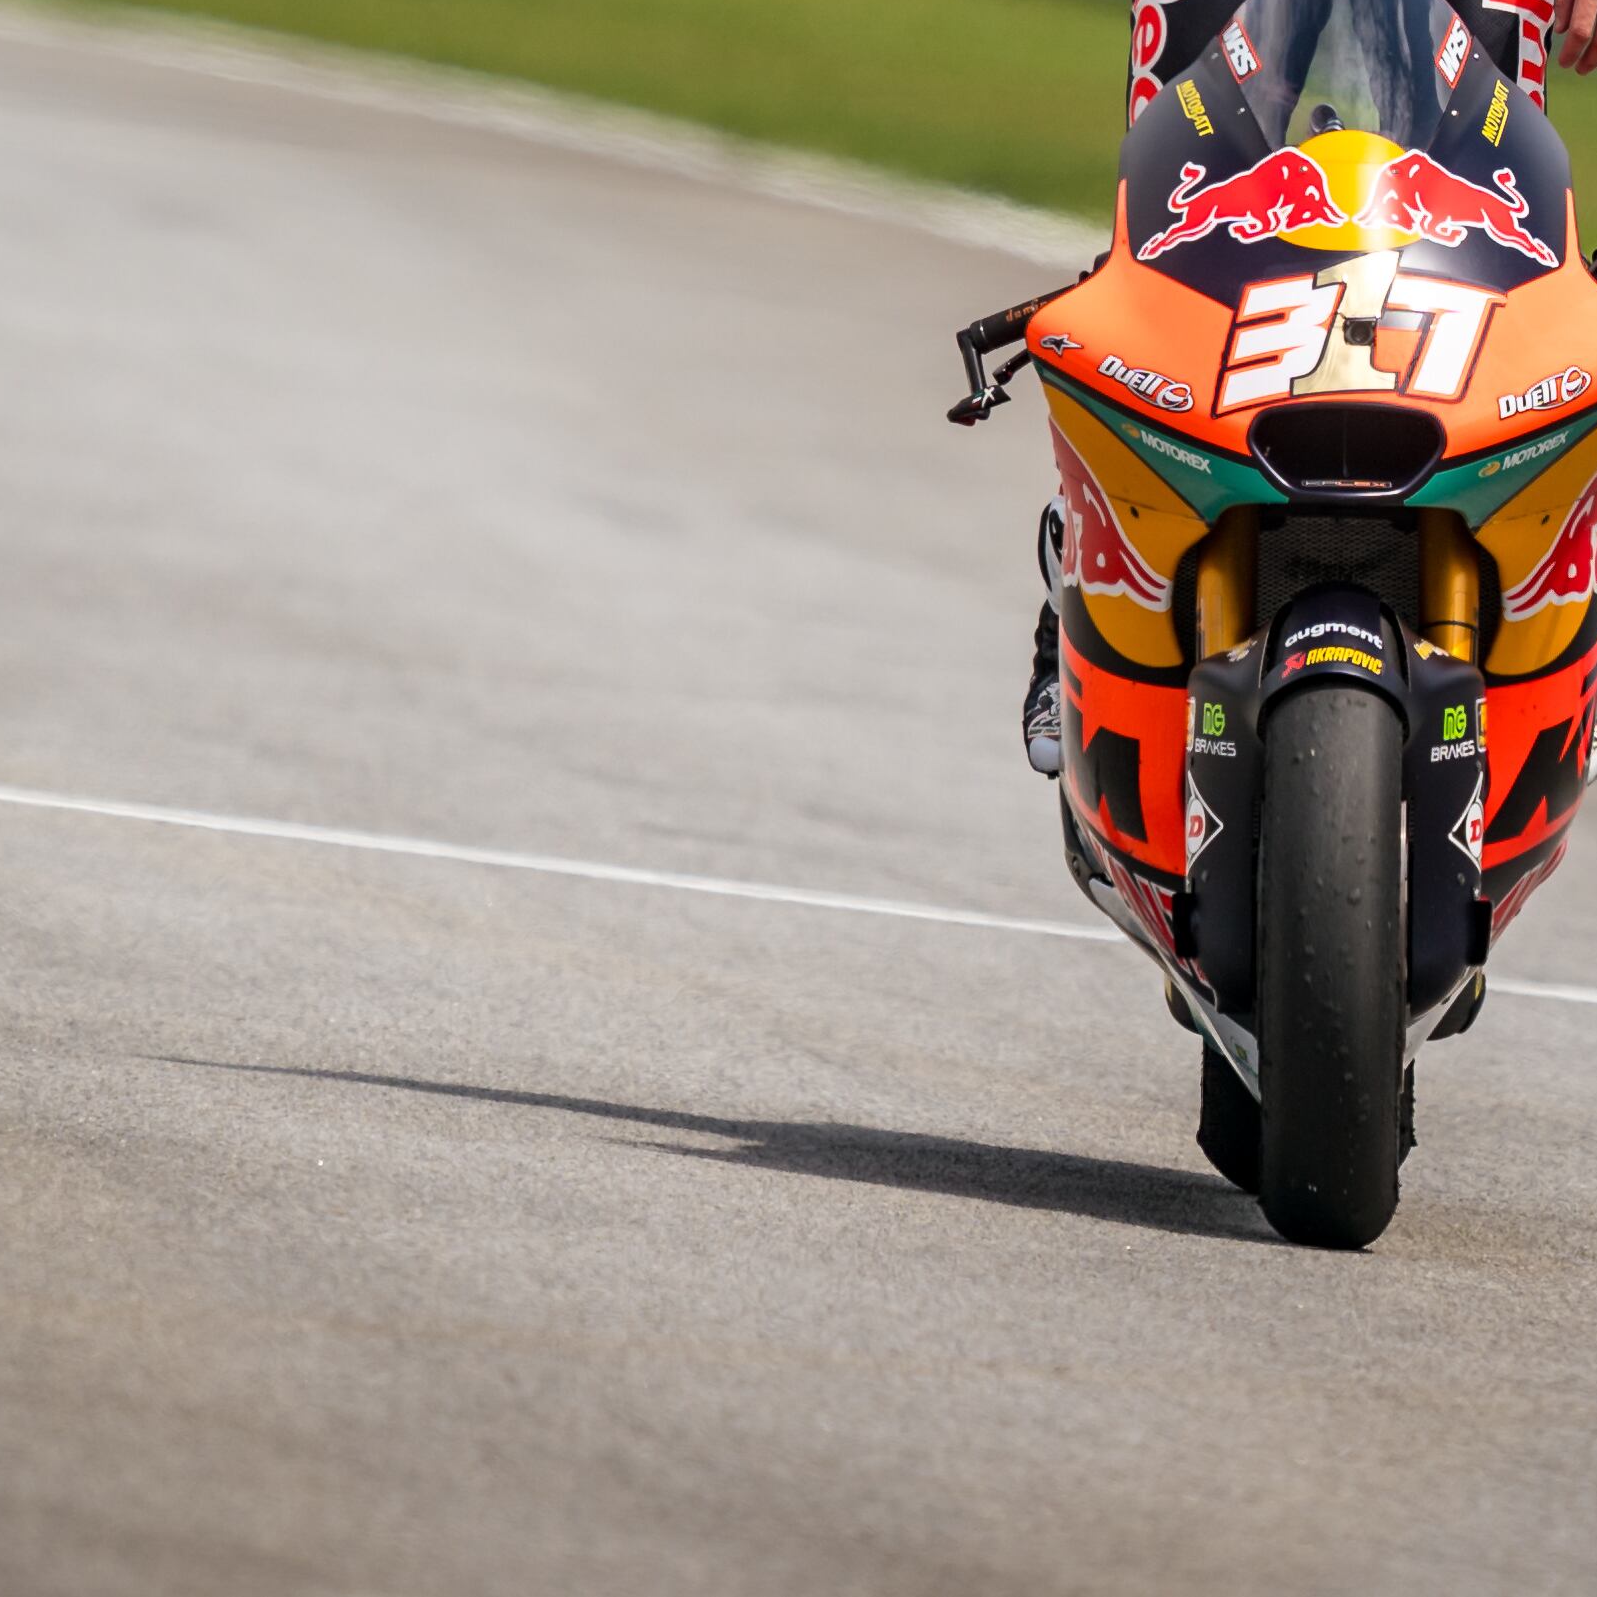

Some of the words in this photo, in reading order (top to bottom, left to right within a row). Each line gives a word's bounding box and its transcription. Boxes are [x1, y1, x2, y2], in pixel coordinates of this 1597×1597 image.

[1176, 78, 1215, 137] MOTOBATT
[1481, 79, 1510, 148] MOTOBATT
[1140, 429, 1213, 475] MOTOREX
[1501, 430, 1570, 472] MOTOREX
[1284, 622, 1384, 650] augment
[1194, 737, 1237, 758] BRAKES
[1430, 739, 1476, 763] BRAKES
